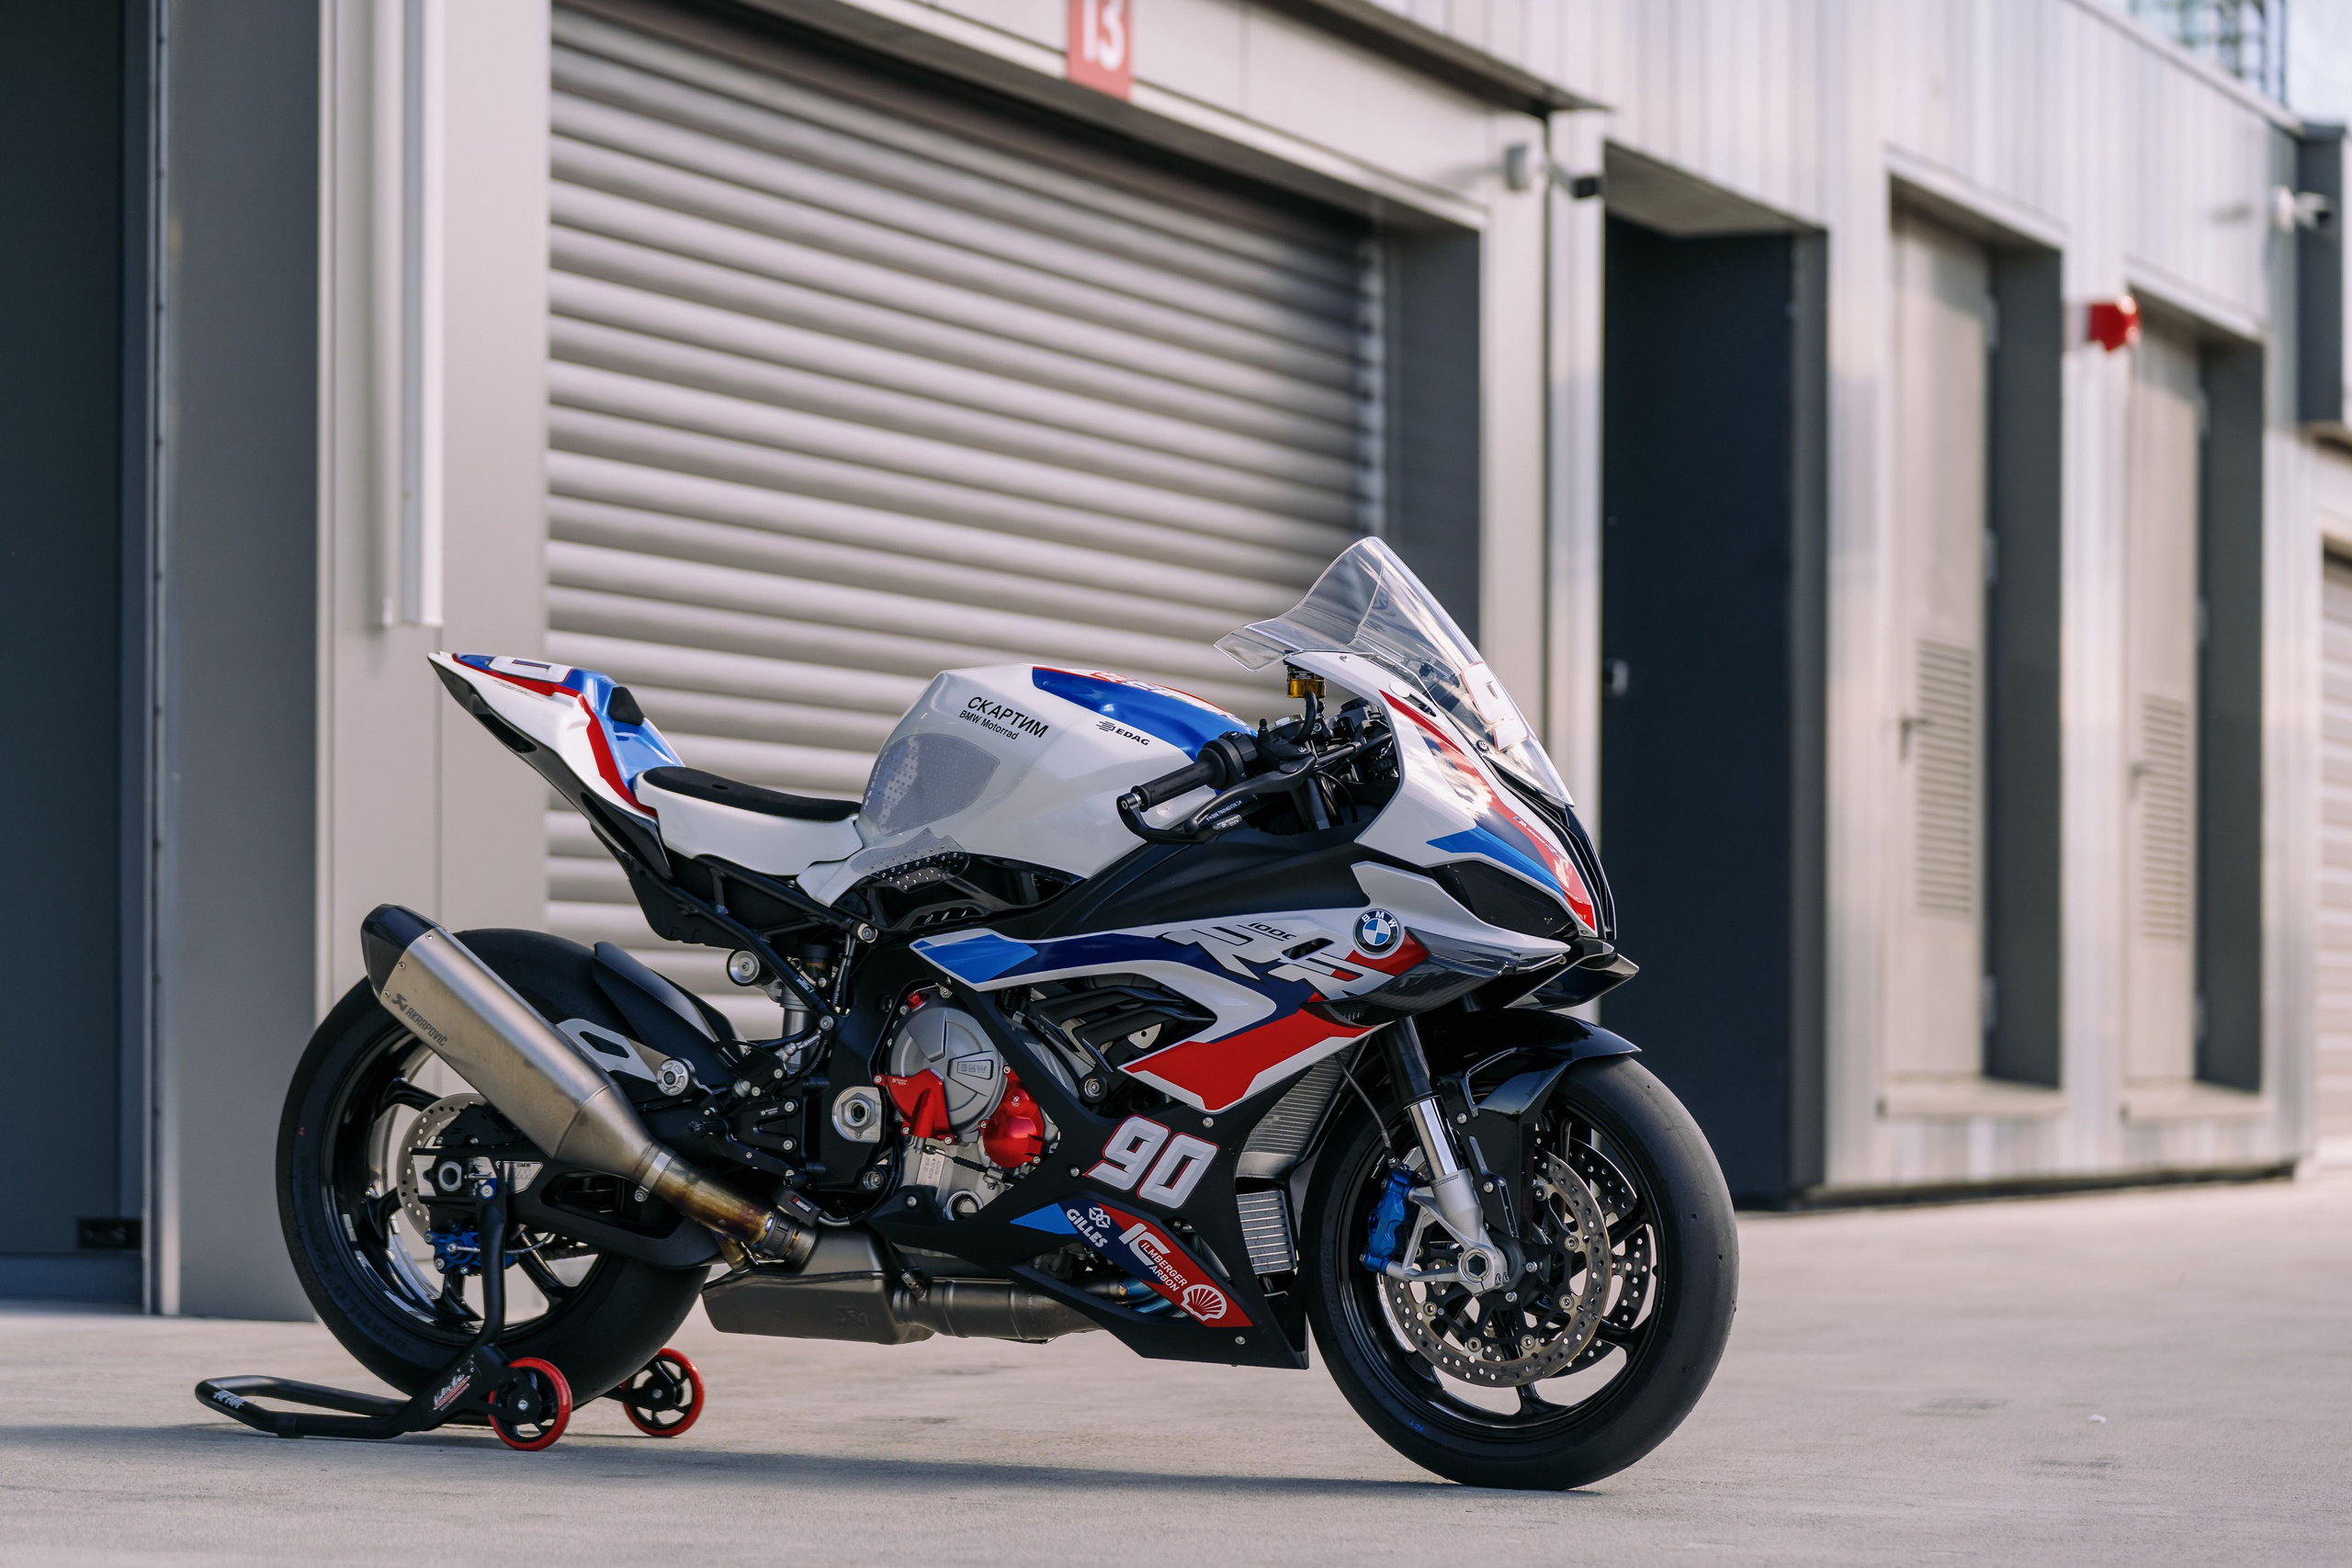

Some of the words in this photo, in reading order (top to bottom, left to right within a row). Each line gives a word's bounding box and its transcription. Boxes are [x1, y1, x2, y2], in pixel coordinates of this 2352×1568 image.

[1082, 0, 1125, 72] 13
[959, 709, 982, 724] BMW
[980, 717, 1020, 740] Motorrad
[967, 696, 1049, 739] СКАРТИМ
[1115, 728, 1150, 746] EDAG
[960, 1063, 988, 1074] BMW
[1083, 1113, 1221, 1210] 90
[1066, 1208, 1108, 1247] GILLES
[1140, 1242, 1188, 1287] ILMBERGER
